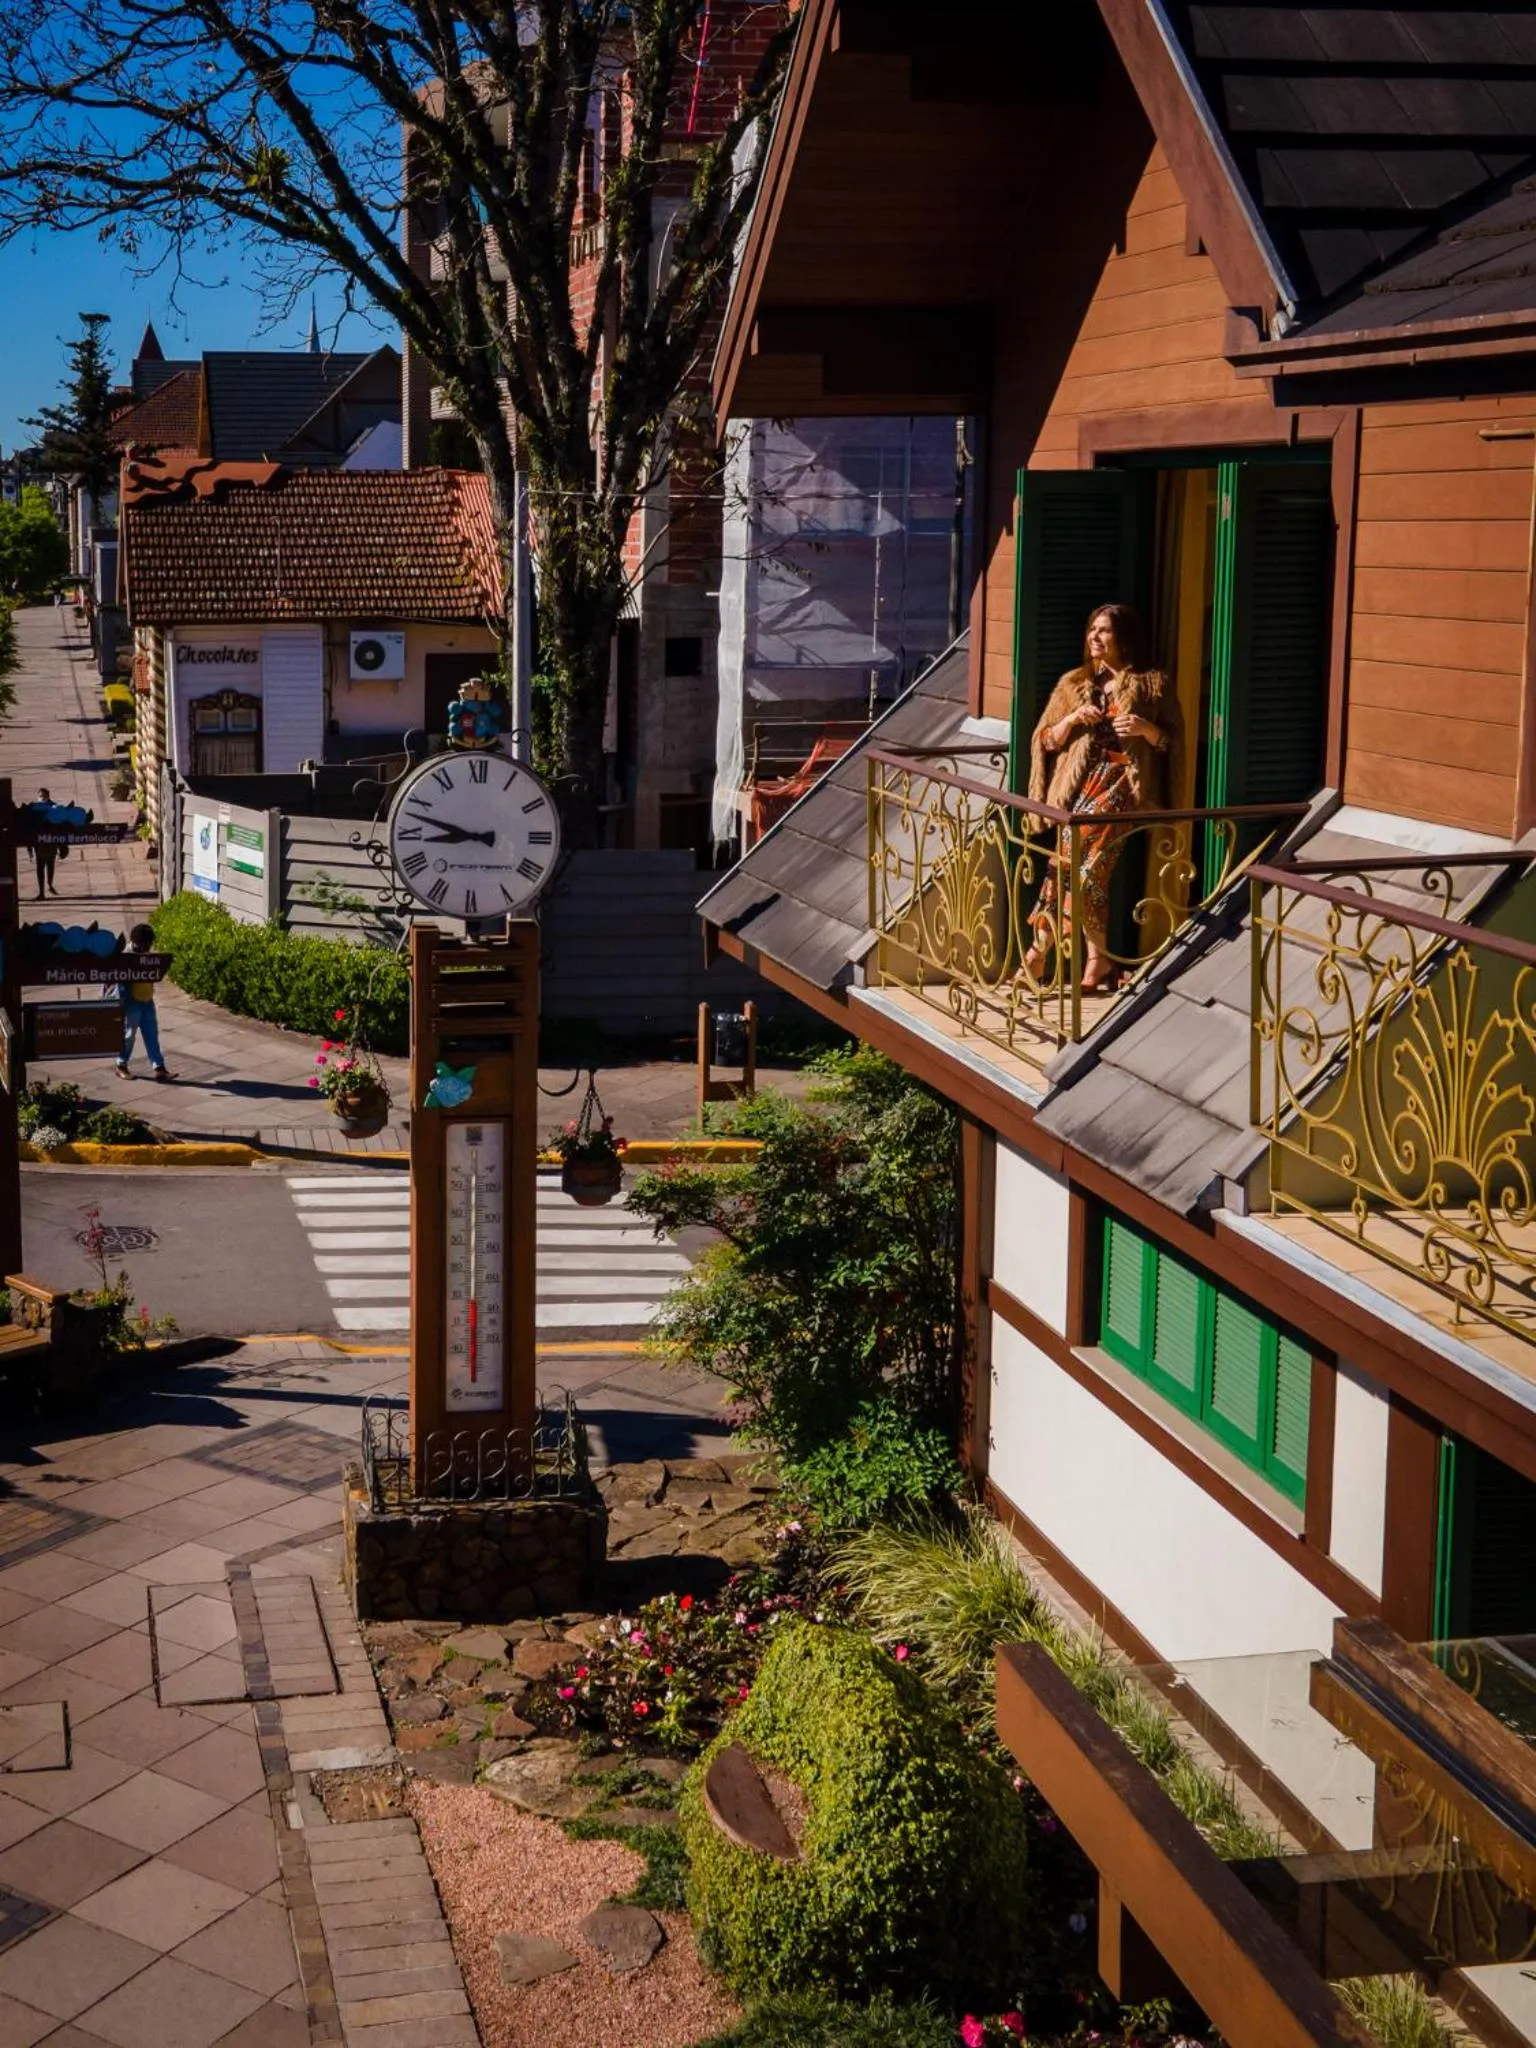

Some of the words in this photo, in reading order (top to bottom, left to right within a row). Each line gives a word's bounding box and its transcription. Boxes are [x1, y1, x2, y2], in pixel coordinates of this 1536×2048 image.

[176, 645, 260, 664] Chocolates
[432, 767, 454, 794] XI
[469, 760, 488, 784] XII
[409, 793, 432, 811] X
[521, 797, 545, 814] II
[68, 832, 118, 844] Bertolucci
[398, 825, 422, 840] IX
[528, 831, 552, 845] III
[427, 878, 450, 904] VII
[500, 884, 514, 905] V
[465, 889, 477, 913] VI
[139, 955, 161, 966] Rua
[46, 967, 86, 982] Mário
[89, 967, 161, 982] Bertolucci
